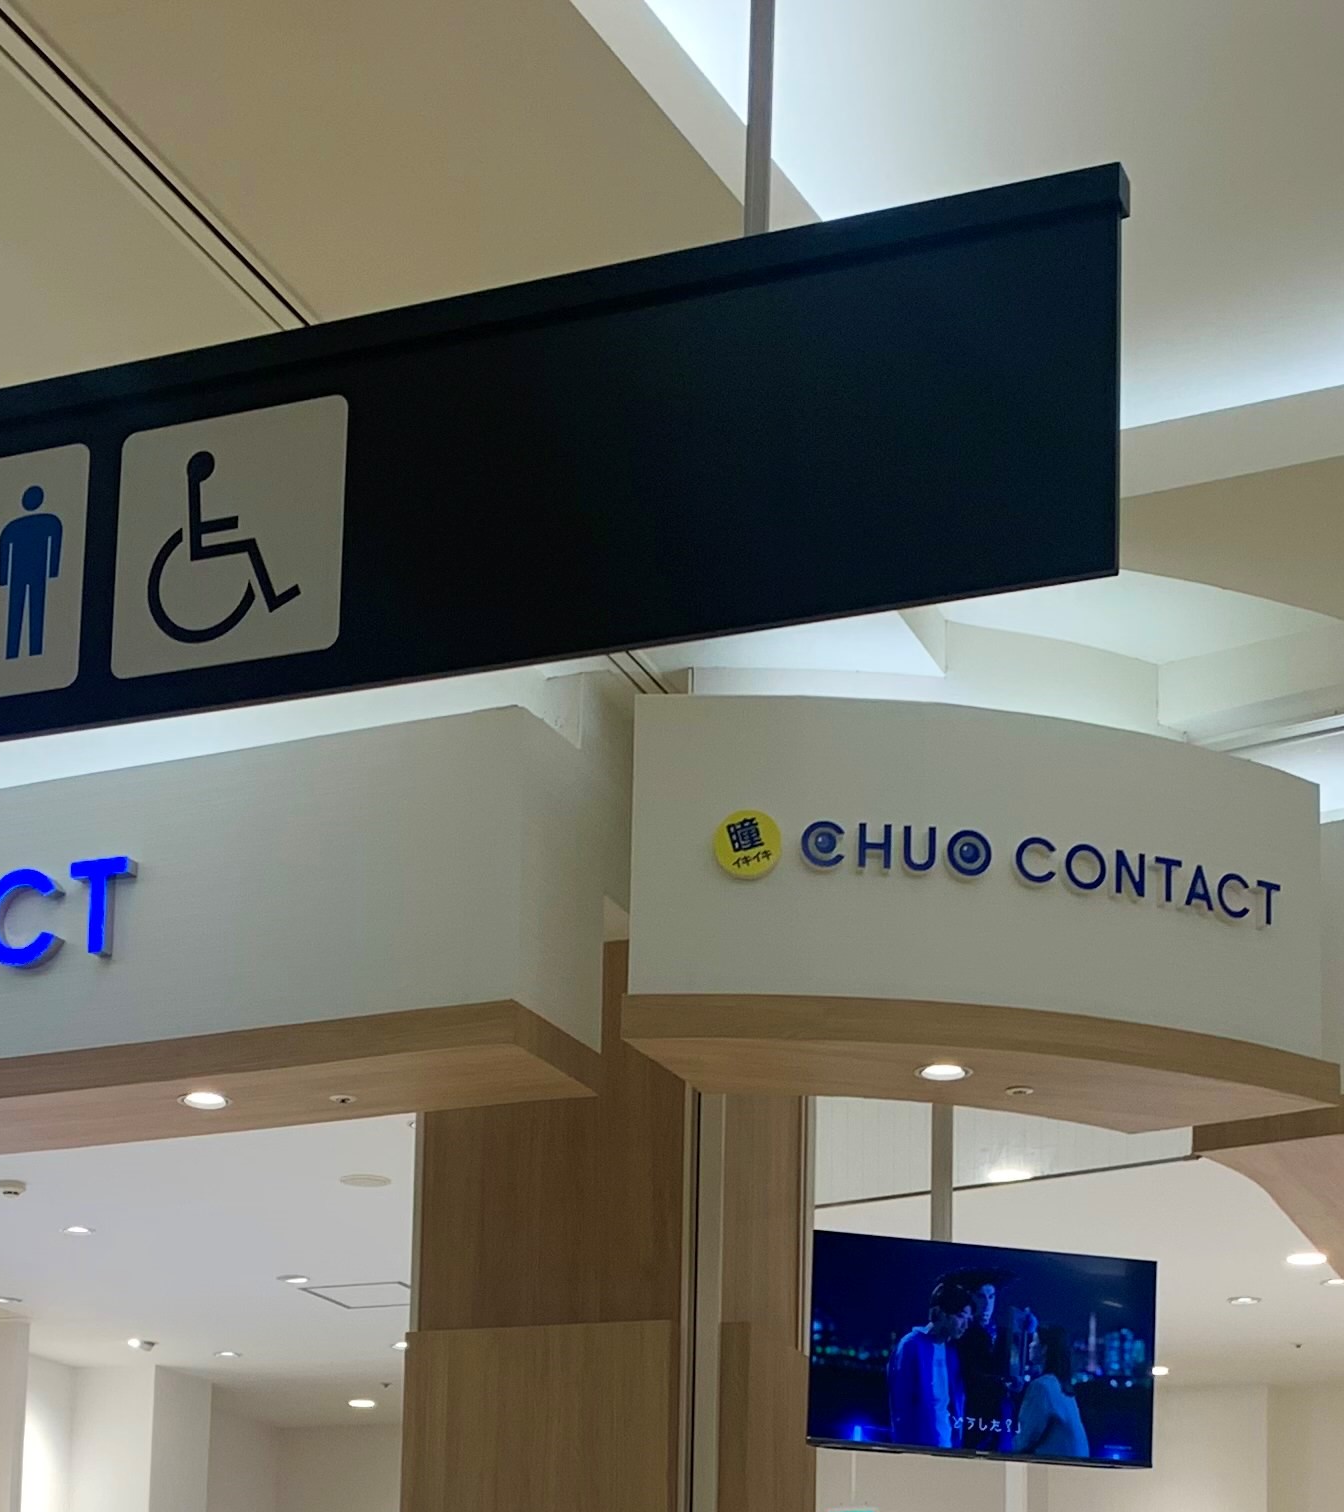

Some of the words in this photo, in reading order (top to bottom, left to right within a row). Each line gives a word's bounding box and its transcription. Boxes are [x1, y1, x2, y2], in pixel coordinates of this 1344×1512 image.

[727, 817, 765, 853] 瞳
[732, 848, 772, 868] イキイキ
[801, 819, 992, 877] CHUO
[1015, 836, 1282, 927] CONTACT
